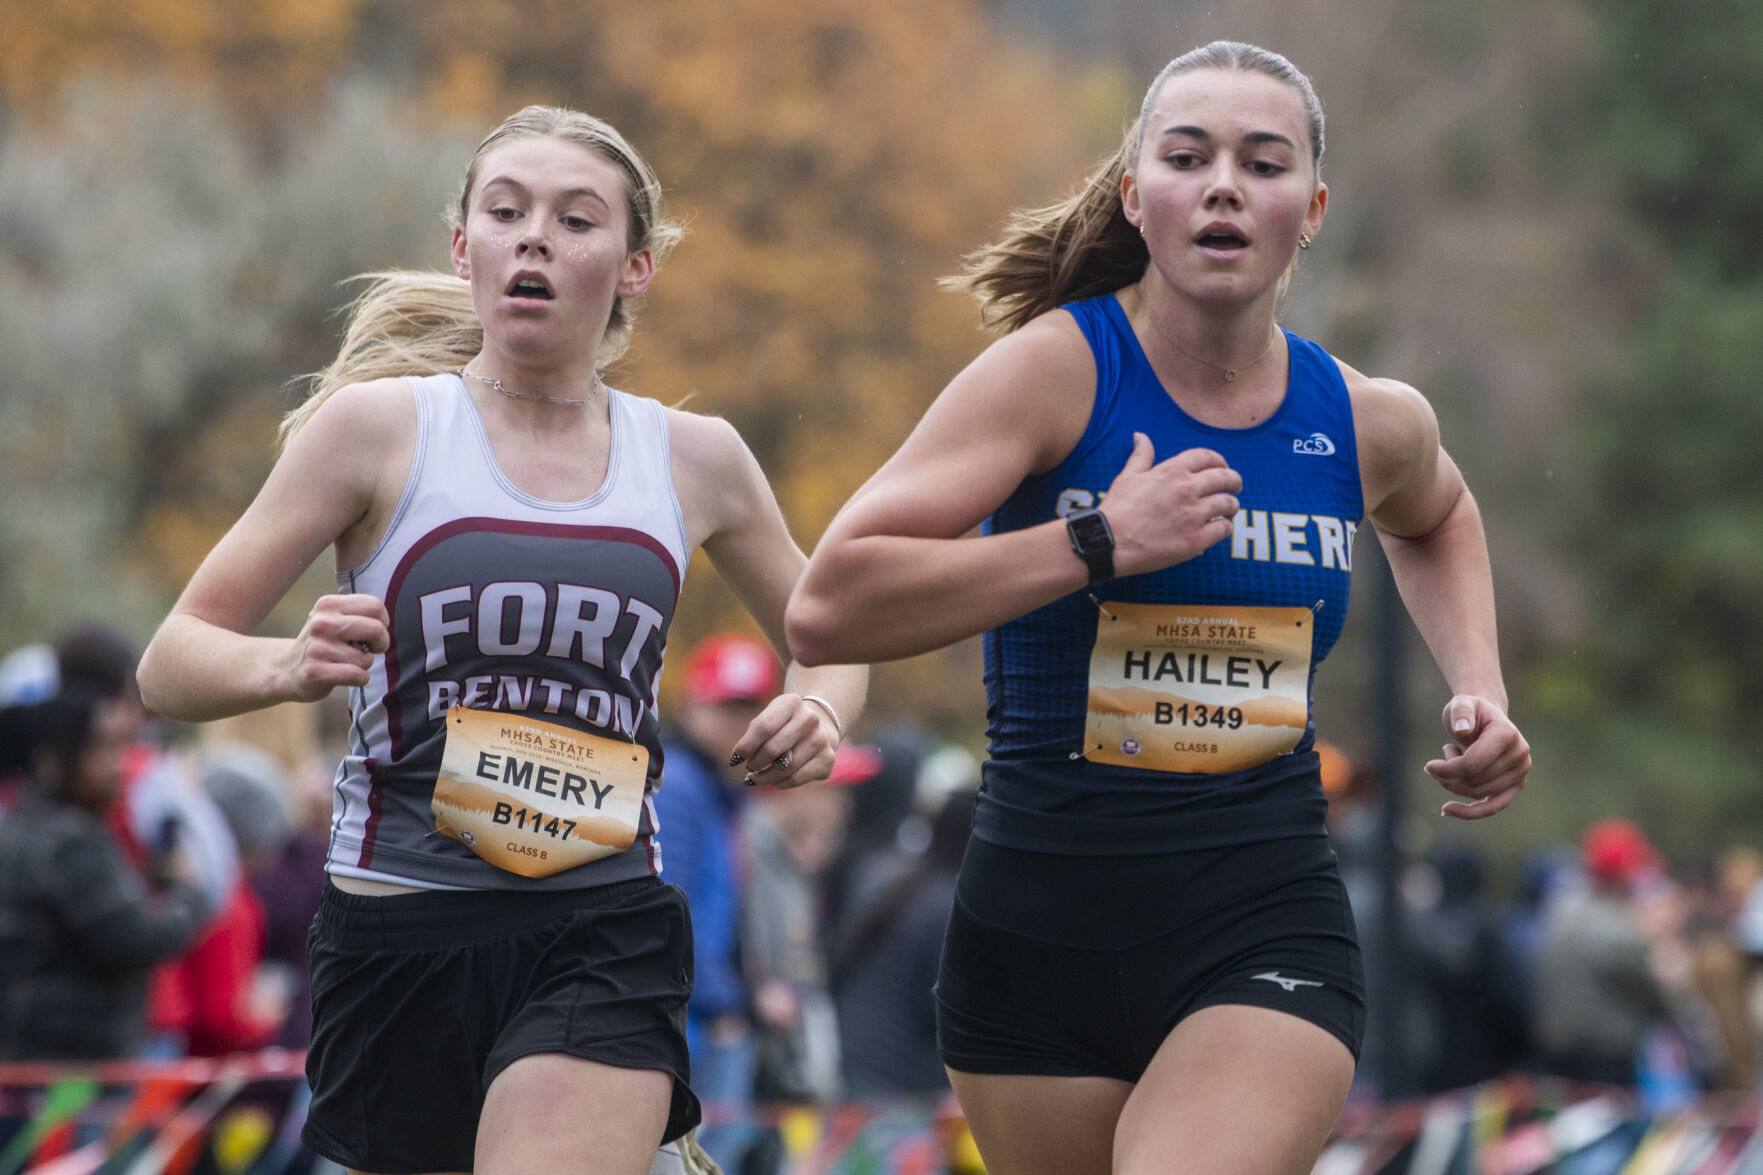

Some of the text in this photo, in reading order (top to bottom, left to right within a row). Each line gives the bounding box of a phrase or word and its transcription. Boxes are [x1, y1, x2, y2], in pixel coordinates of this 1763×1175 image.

[1293, 438, 1325, 454] PCS
[419, 580, 664, 681] FORT
[1156, 624, 1257, 639] MHSA STATE
[1202, 617, 1239, 626] ANNUAL
[1123, 650, 1283, 690] HAILEY
[426, 674, 645, 734] BENTON
[1154, 701, 1243, 730] B1349
[500, 728, 595, 759] MHSA STATE
[544, 731, 577, 744] ANNUAL
[1174, 742, 1218, 753] CLASS B
[533, 745, 565, 757] COUNTRY
[567, 753, 585, 763] MEET
[475, 751, 615, 810] EMERY
[492, 801, 577, 841] B1147
[506, 842, 548, 860] CLASS B
